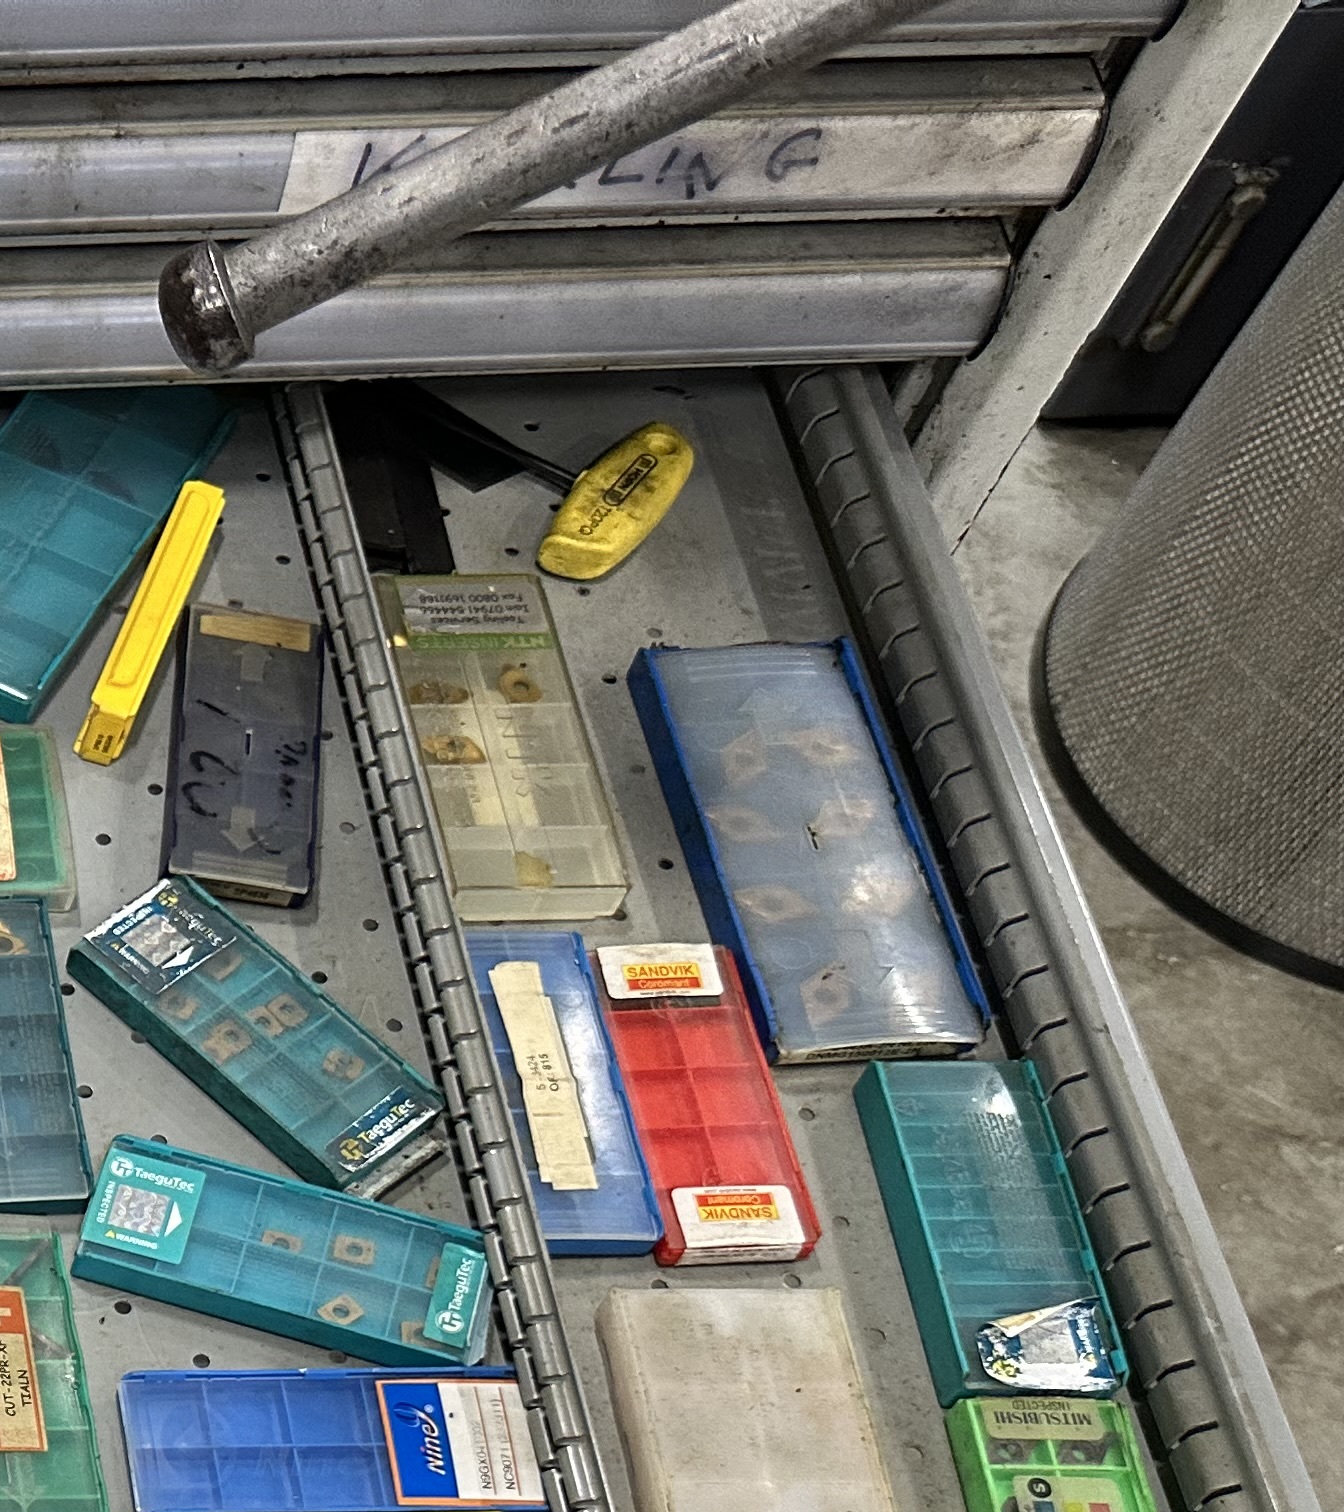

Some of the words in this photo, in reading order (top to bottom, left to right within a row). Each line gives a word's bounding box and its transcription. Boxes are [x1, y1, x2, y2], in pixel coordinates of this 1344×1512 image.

[627, 965, 694, 976] SANDVIK
[356, 1096, 417, 1147] TaeguTec
[132, 1166, 195, 1193] TaeguTec
[701, 1206, 772, 1220] SANDVIK
[447, 1256, 475, 1312] TaeguTec
[16, 1368, 32, 1407] TIALN
[993, 1411, 1091, 1425] MITSUBISHI
